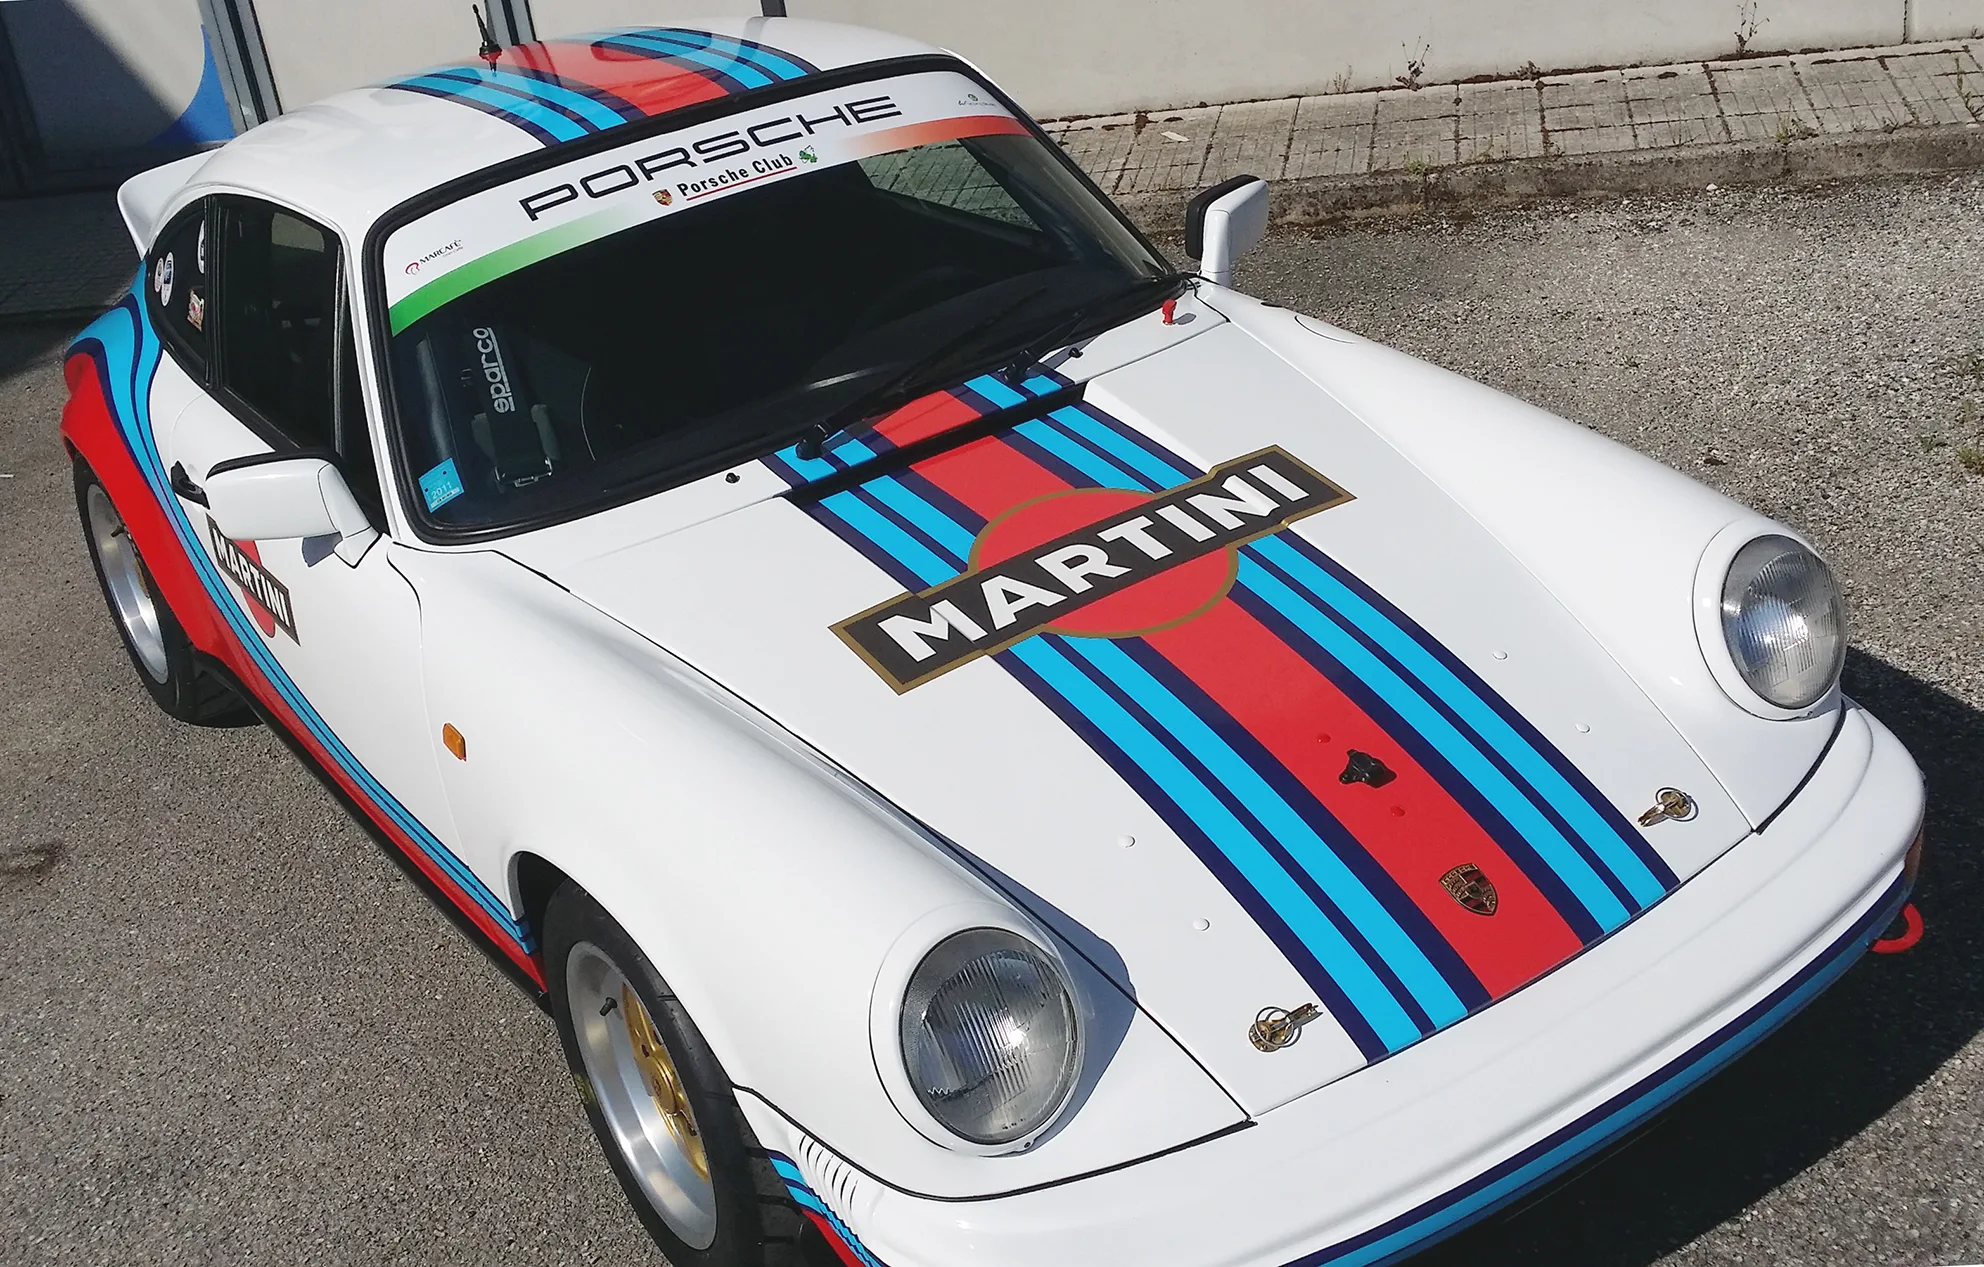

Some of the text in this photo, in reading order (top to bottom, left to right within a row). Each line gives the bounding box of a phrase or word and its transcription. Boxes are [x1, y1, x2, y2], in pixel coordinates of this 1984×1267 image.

[518, 95, 902, 222] PORSCHE
[676, 153, 793, 197] Porsche Club
[431, 480, 453, 500] 2011
[212, 527, 291, 628] MARTINI
[877, 464, 1310, 663] MARTINI
